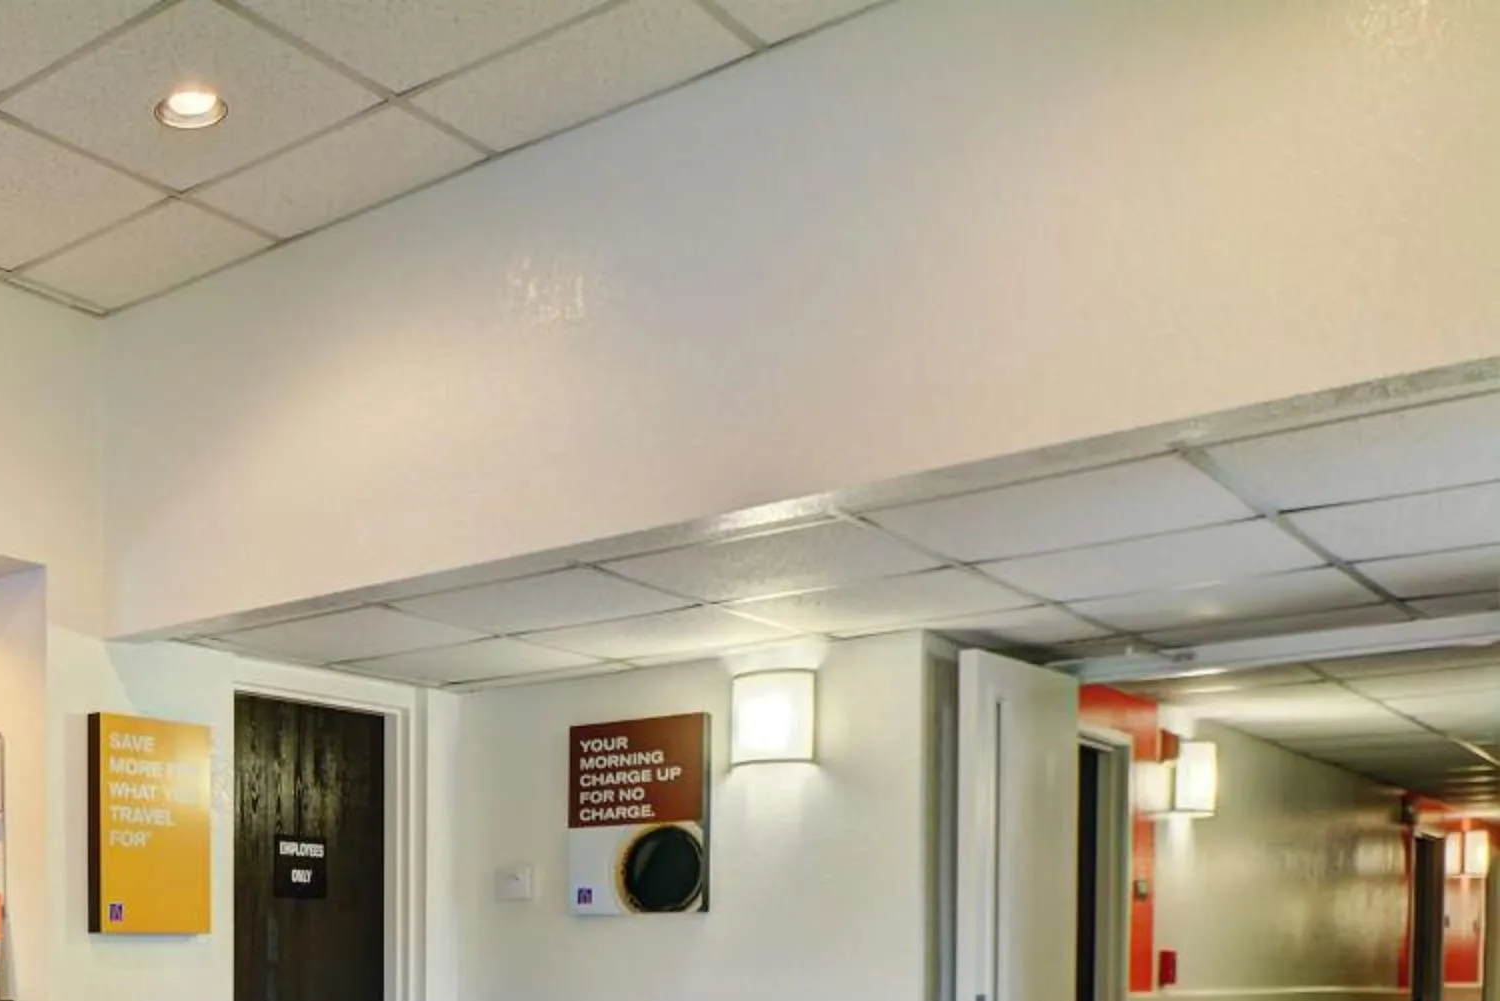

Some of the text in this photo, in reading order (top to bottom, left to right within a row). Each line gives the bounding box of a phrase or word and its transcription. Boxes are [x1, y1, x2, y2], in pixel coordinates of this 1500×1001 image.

[108, 732, 155, 752] SAVE
[580, 736, 628, 753] YOUR
[109, 755, 164, 778] MORE
[580, 750, 664, 770] MORNING
[580, 766, 682, 787] CHARGE UP
[109, 782, 155, 801] WHAT
[580, 787, 644, 804] FOR NO
[110, 805, 176, 827] TRAVEL
[580, 804, 655, 821] CHARGE.
[279, 841, 324, 858] EMPLOYEES
[291, 869, 312, 883] ONLY
